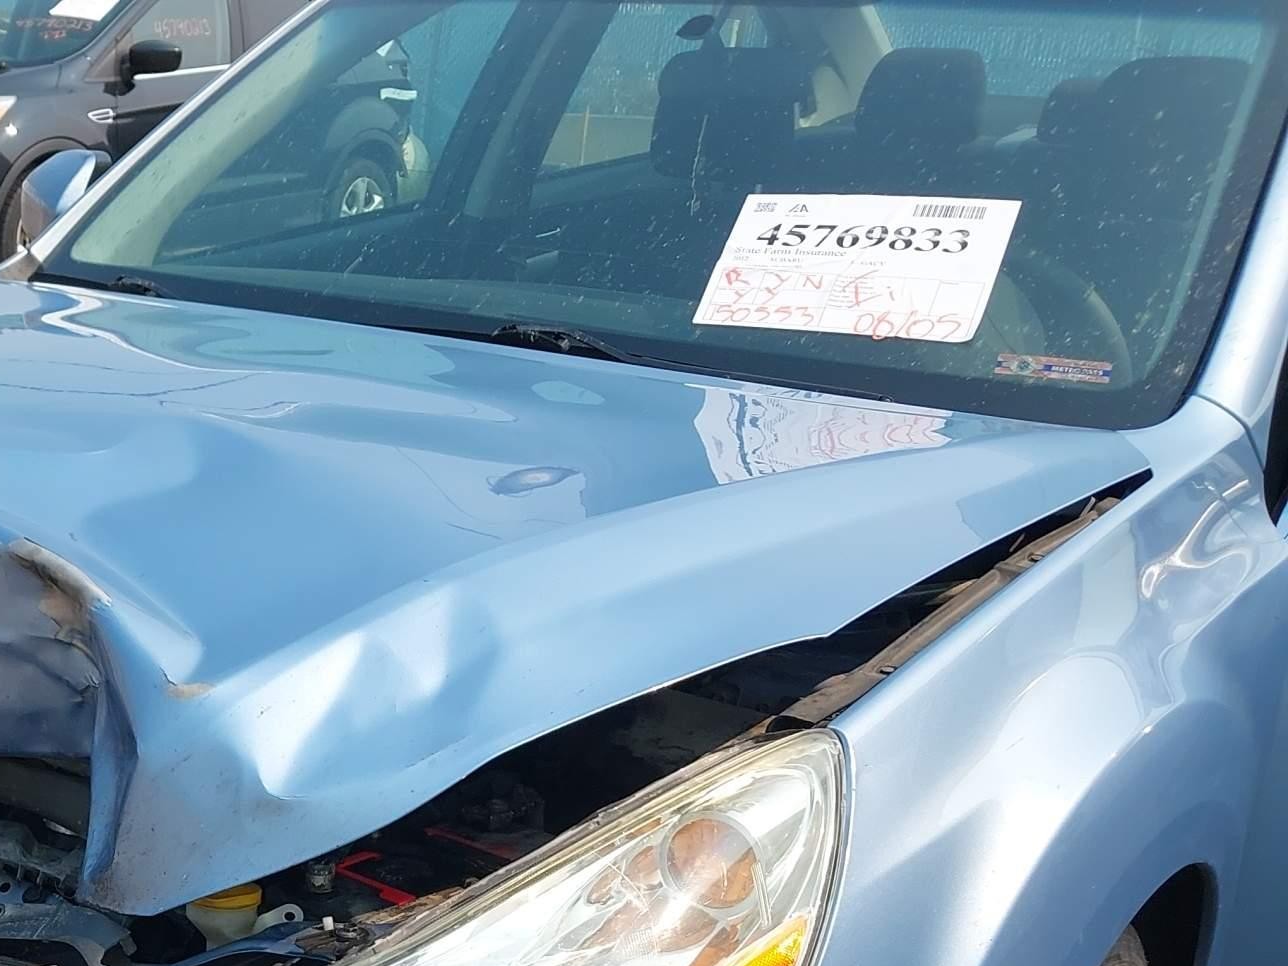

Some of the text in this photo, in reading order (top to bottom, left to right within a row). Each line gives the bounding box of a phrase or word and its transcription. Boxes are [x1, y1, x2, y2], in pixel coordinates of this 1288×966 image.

[756, 223, 971, 253] 45769833
[734, 246, 847, 257] State Farm Insurance
